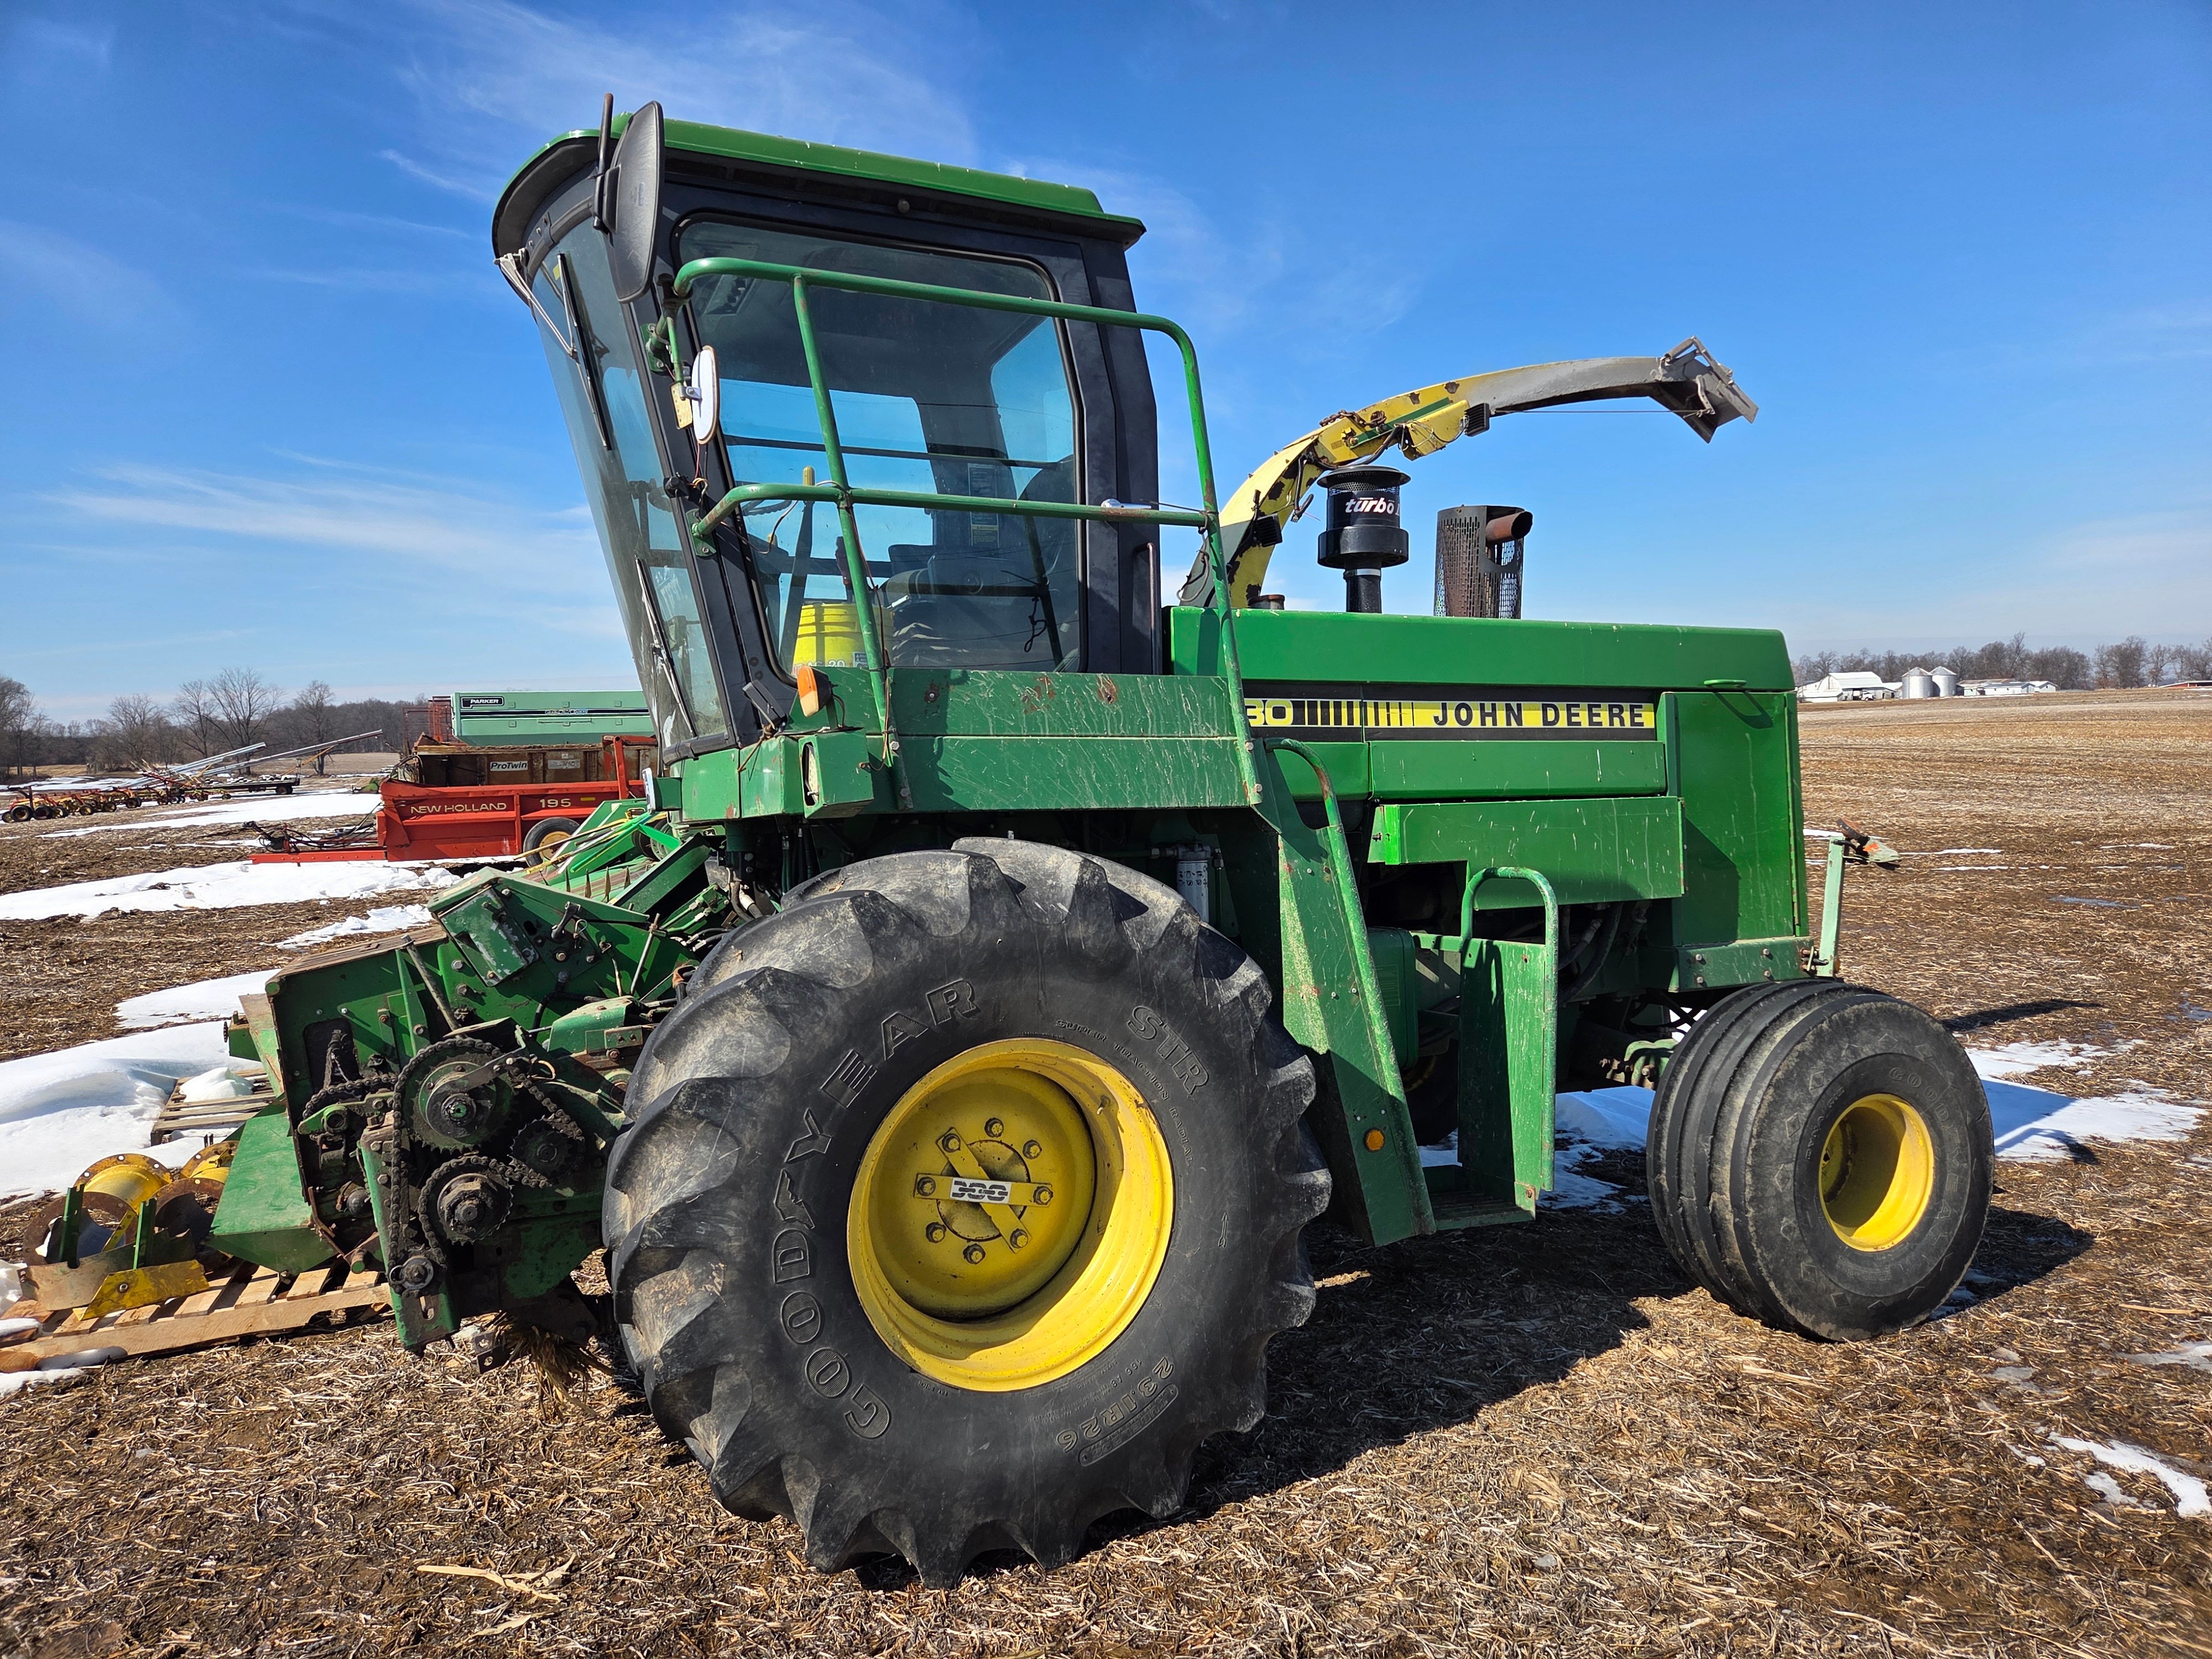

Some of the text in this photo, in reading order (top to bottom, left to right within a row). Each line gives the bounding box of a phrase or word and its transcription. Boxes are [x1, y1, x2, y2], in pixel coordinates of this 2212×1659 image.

[1433, 703, 1524, 727] JOHN
[1542, 703, 1645, 728] DEERE
[410, 802, 507, 814] NEW HOLLAND
[540, 799, 571, 808] 195
[1126, 1005, 1209, 1095] STR
[1055, 1019, 1194, 1166] SUPER TRACTION RADIAL
[773, 978, 981, 1438] GOODYEAR
[1124, 1358, 1142, 1375] 166
[1110, 1374, 1123, 1387] A8
[1056, 1356, 1175, 1453] 23.1R26
